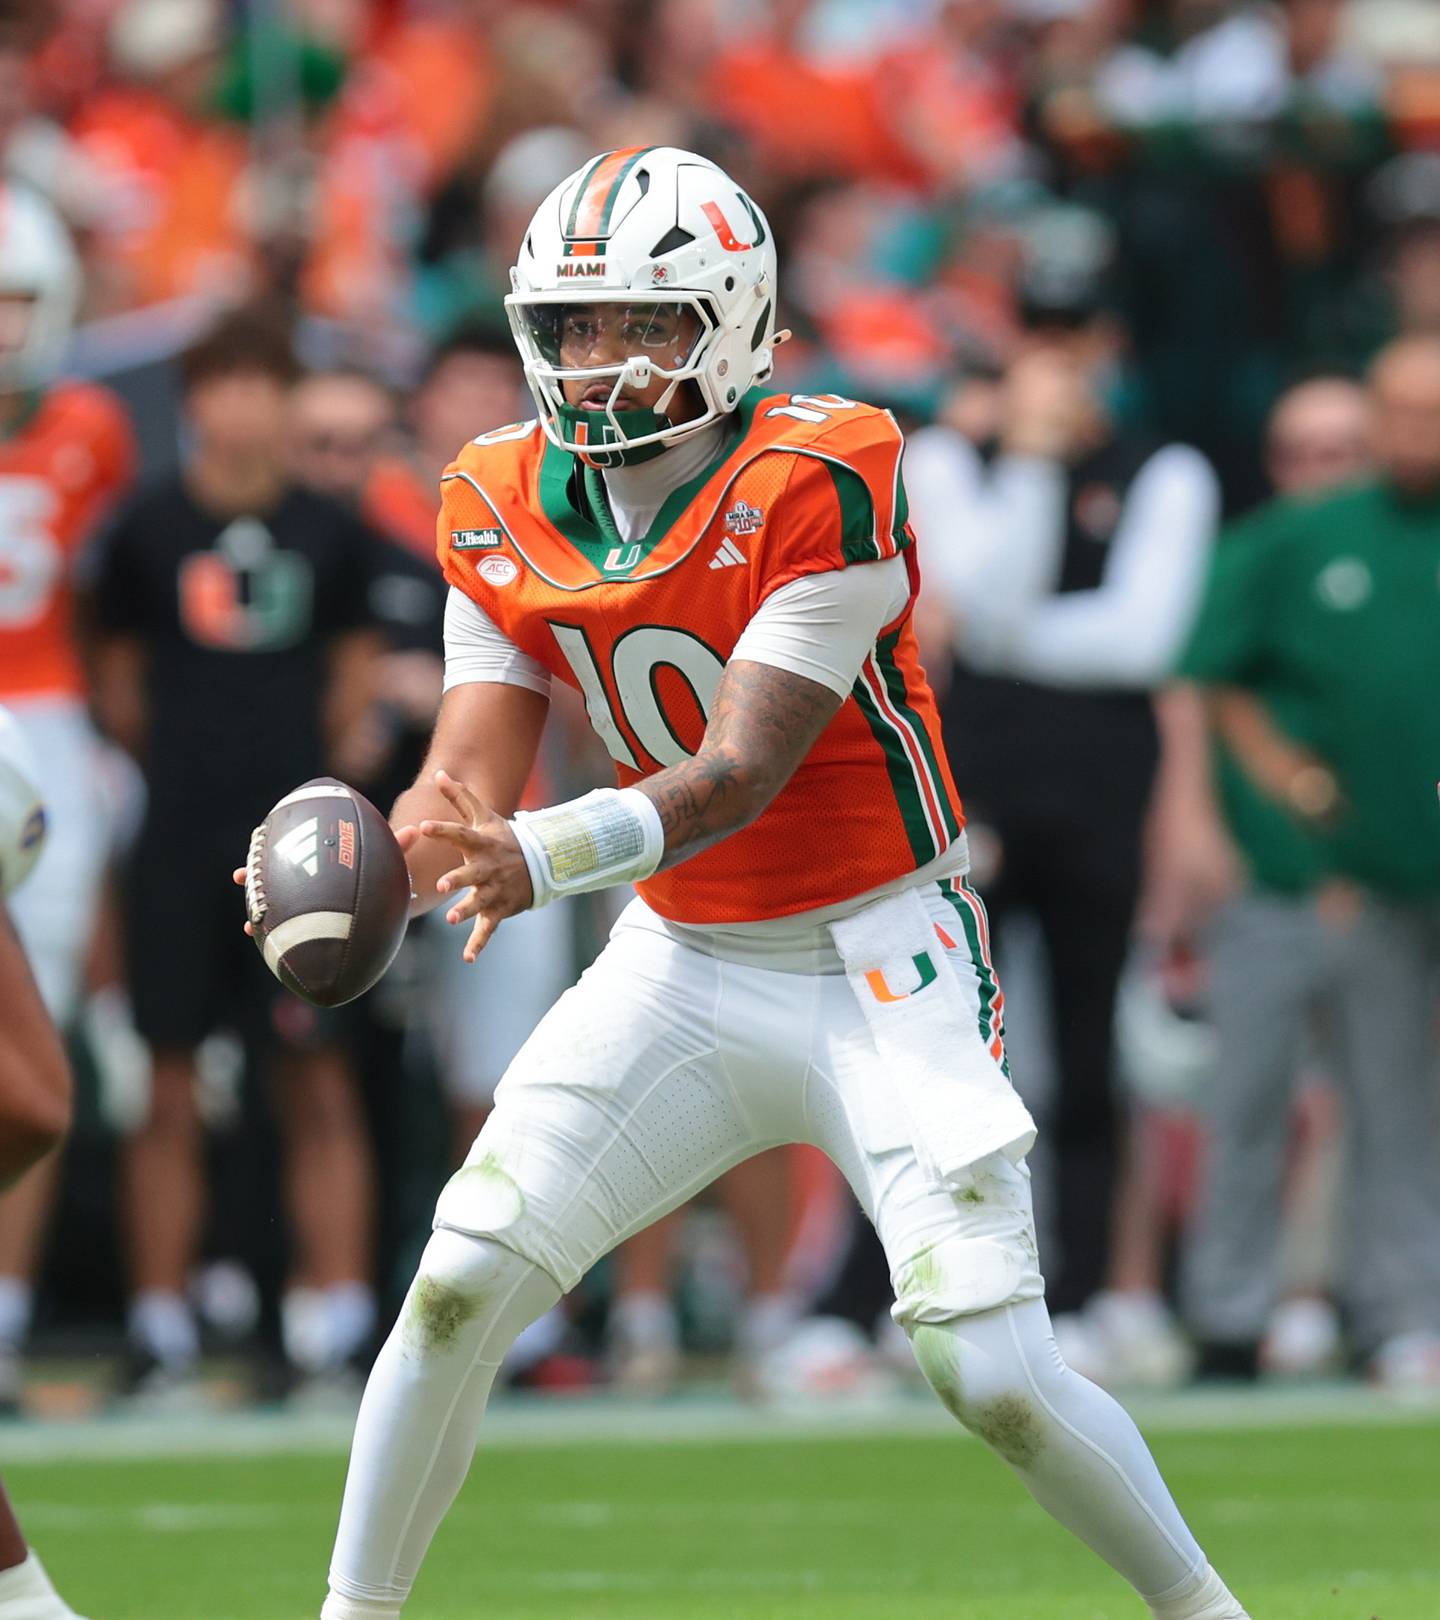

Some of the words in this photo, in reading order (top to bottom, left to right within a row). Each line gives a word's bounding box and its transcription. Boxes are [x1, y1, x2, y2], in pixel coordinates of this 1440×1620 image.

[700, 192, 766, 252] U
[557, 263, 606, 278] MIAMI
[635, 368, 648, 377] U
[765, 393, 858, 424] 10
[451, 529, 499, 547] UHealth
[485, 563, 511, 574] ACC
[603, 544, 641, 571] U
[544, 617, 727, 776] 10
[338, 818, 355, 870] DIME
[864, 950, 938, 1004] U
